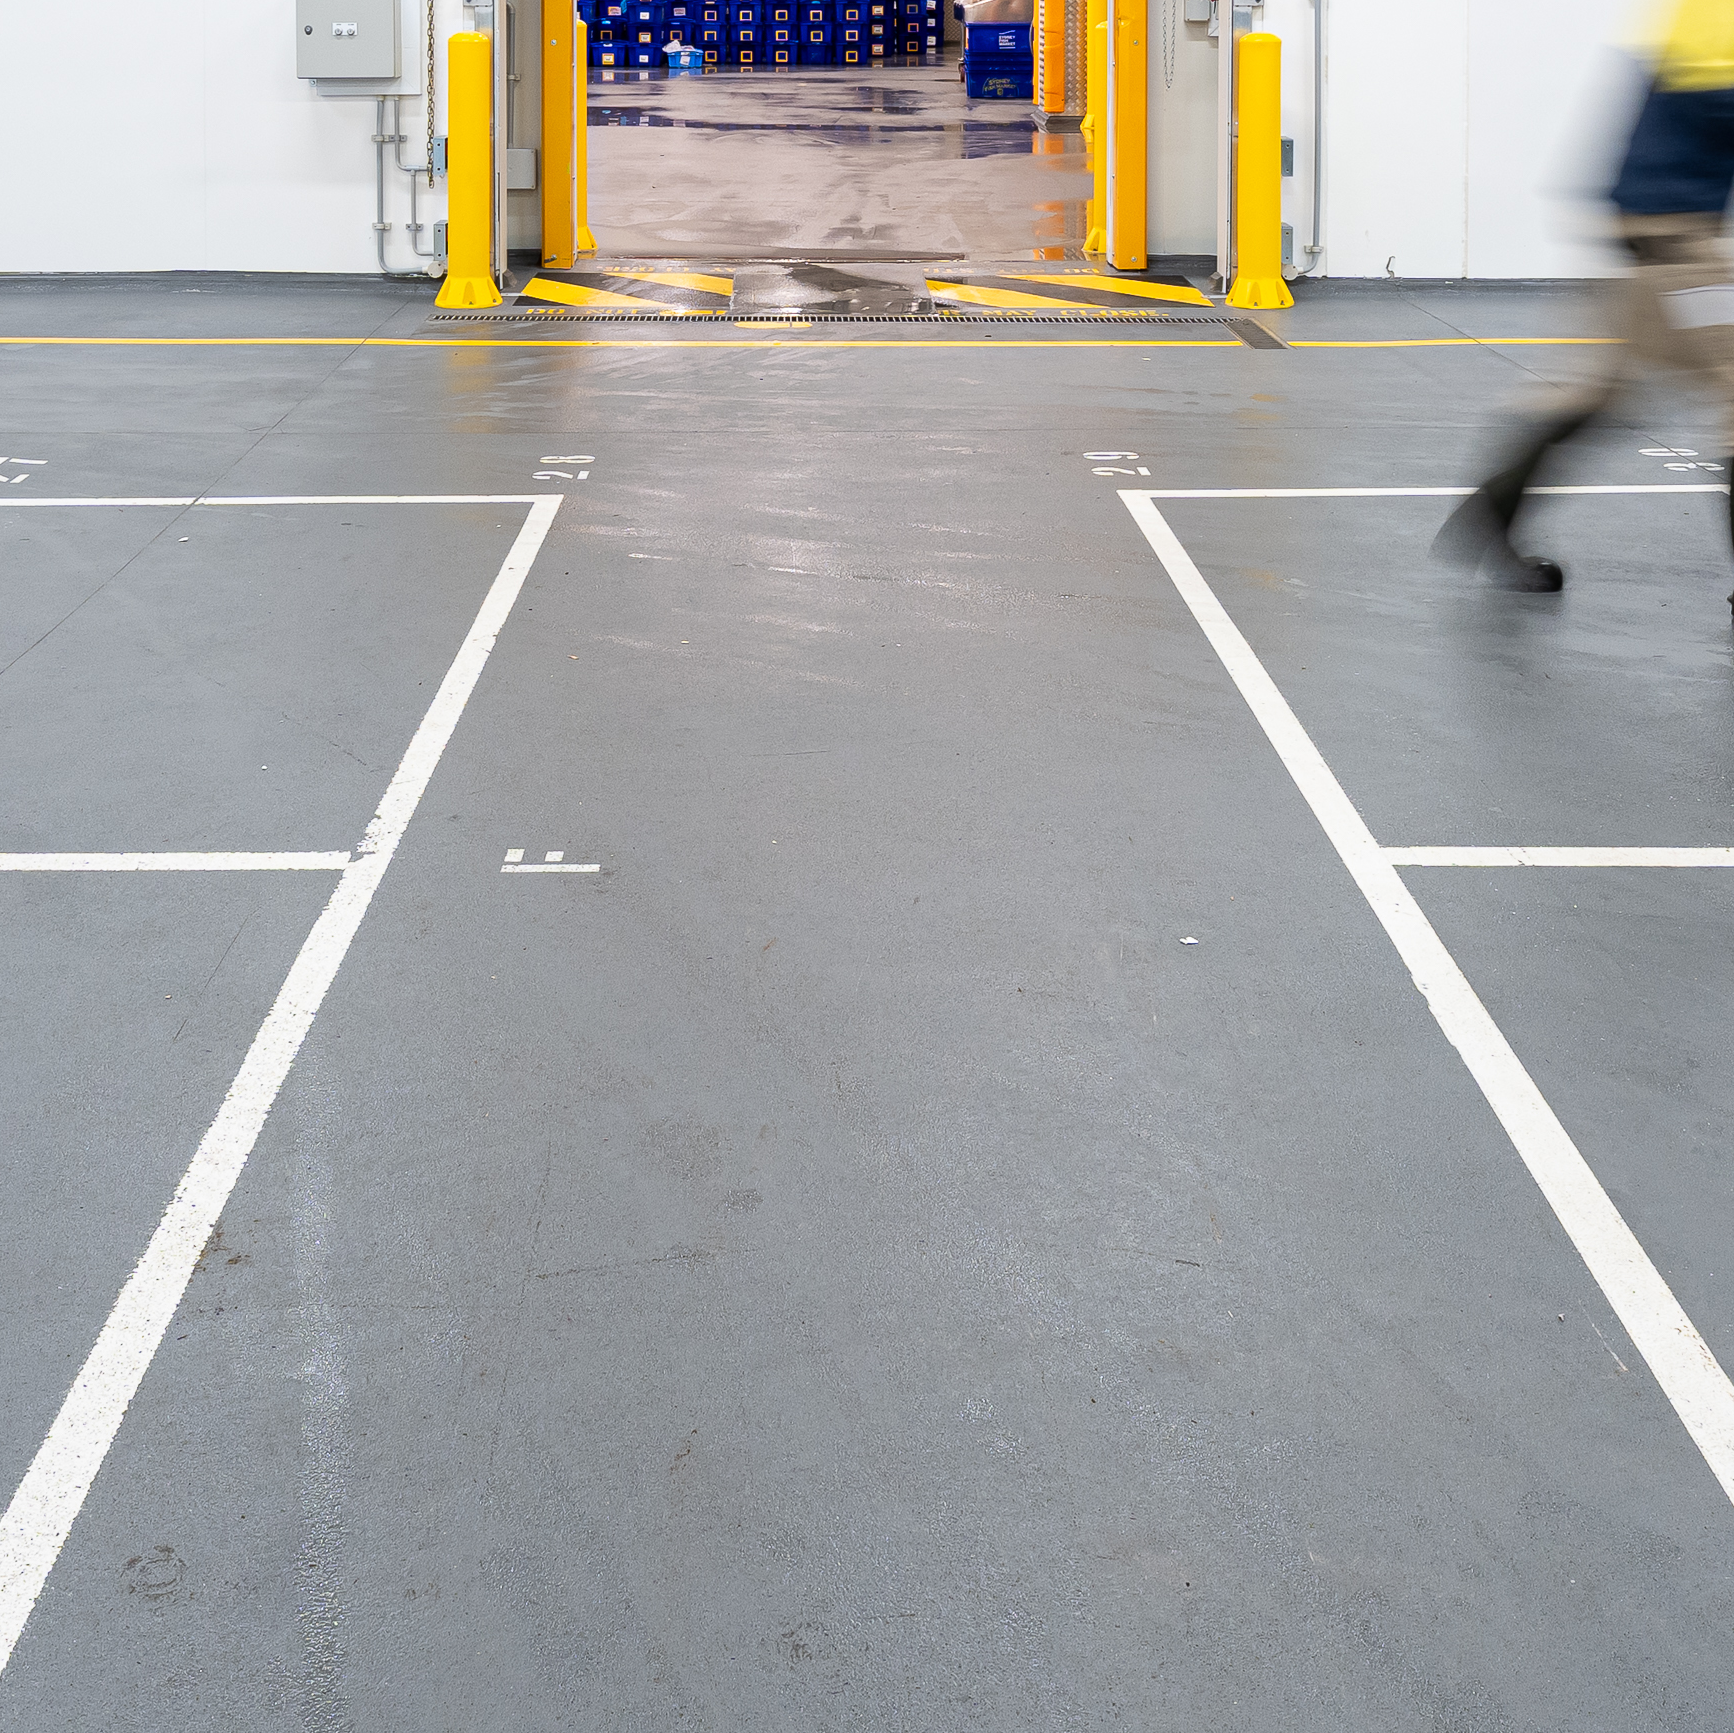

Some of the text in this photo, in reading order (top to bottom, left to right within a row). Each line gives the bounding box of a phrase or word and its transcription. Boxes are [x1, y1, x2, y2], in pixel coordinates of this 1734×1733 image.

[531, 455, 596, 480] 28
[1082, 451, 1151, 476] 29
[499, 848, 601, 873] F
